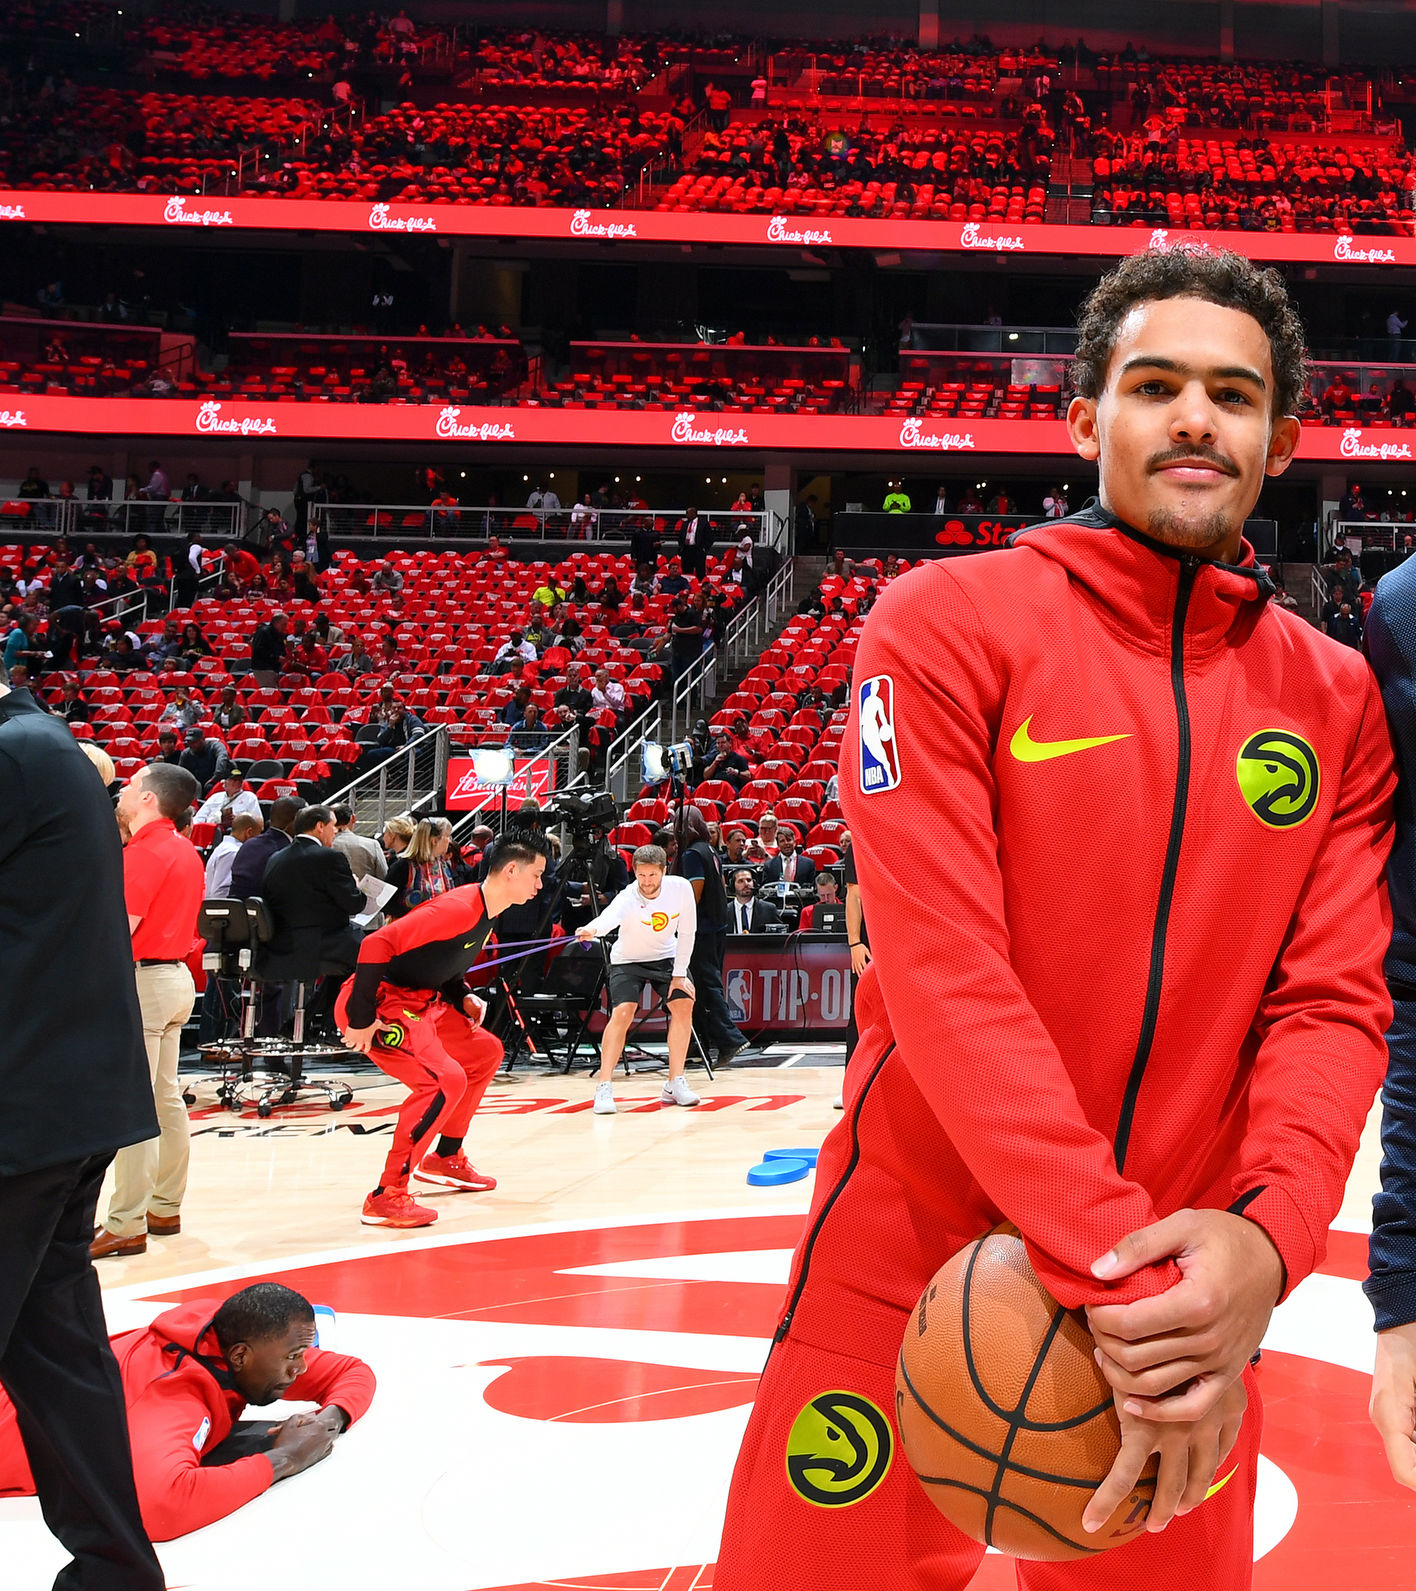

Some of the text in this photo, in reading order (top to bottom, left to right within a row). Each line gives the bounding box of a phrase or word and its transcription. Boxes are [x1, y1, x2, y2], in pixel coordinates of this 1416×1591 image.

[164, 196, 232, 225] Chick-fil-A
[369, 203, 436, 232] Chick-fil-A
[571, 209, 636, 238] Chick-fil-A
[767, 216, 832, 244] Chick-fil-A
[961, 223, 1024, 250] Chick-fil-A
[1334, 235, 1395, 262] Chick-fil-A
[196, 401, 276, 435] Chick-fil-A
[436, 406, 514, 440] Chick-fil-A
[672, 412, 748, 445] Chick-fil-A
[900, 418, 975, 450] Chick-fil-A
[1340, 428, 1412, 459] Chick-fil-A
[864, 765, 884, 787] NBA
